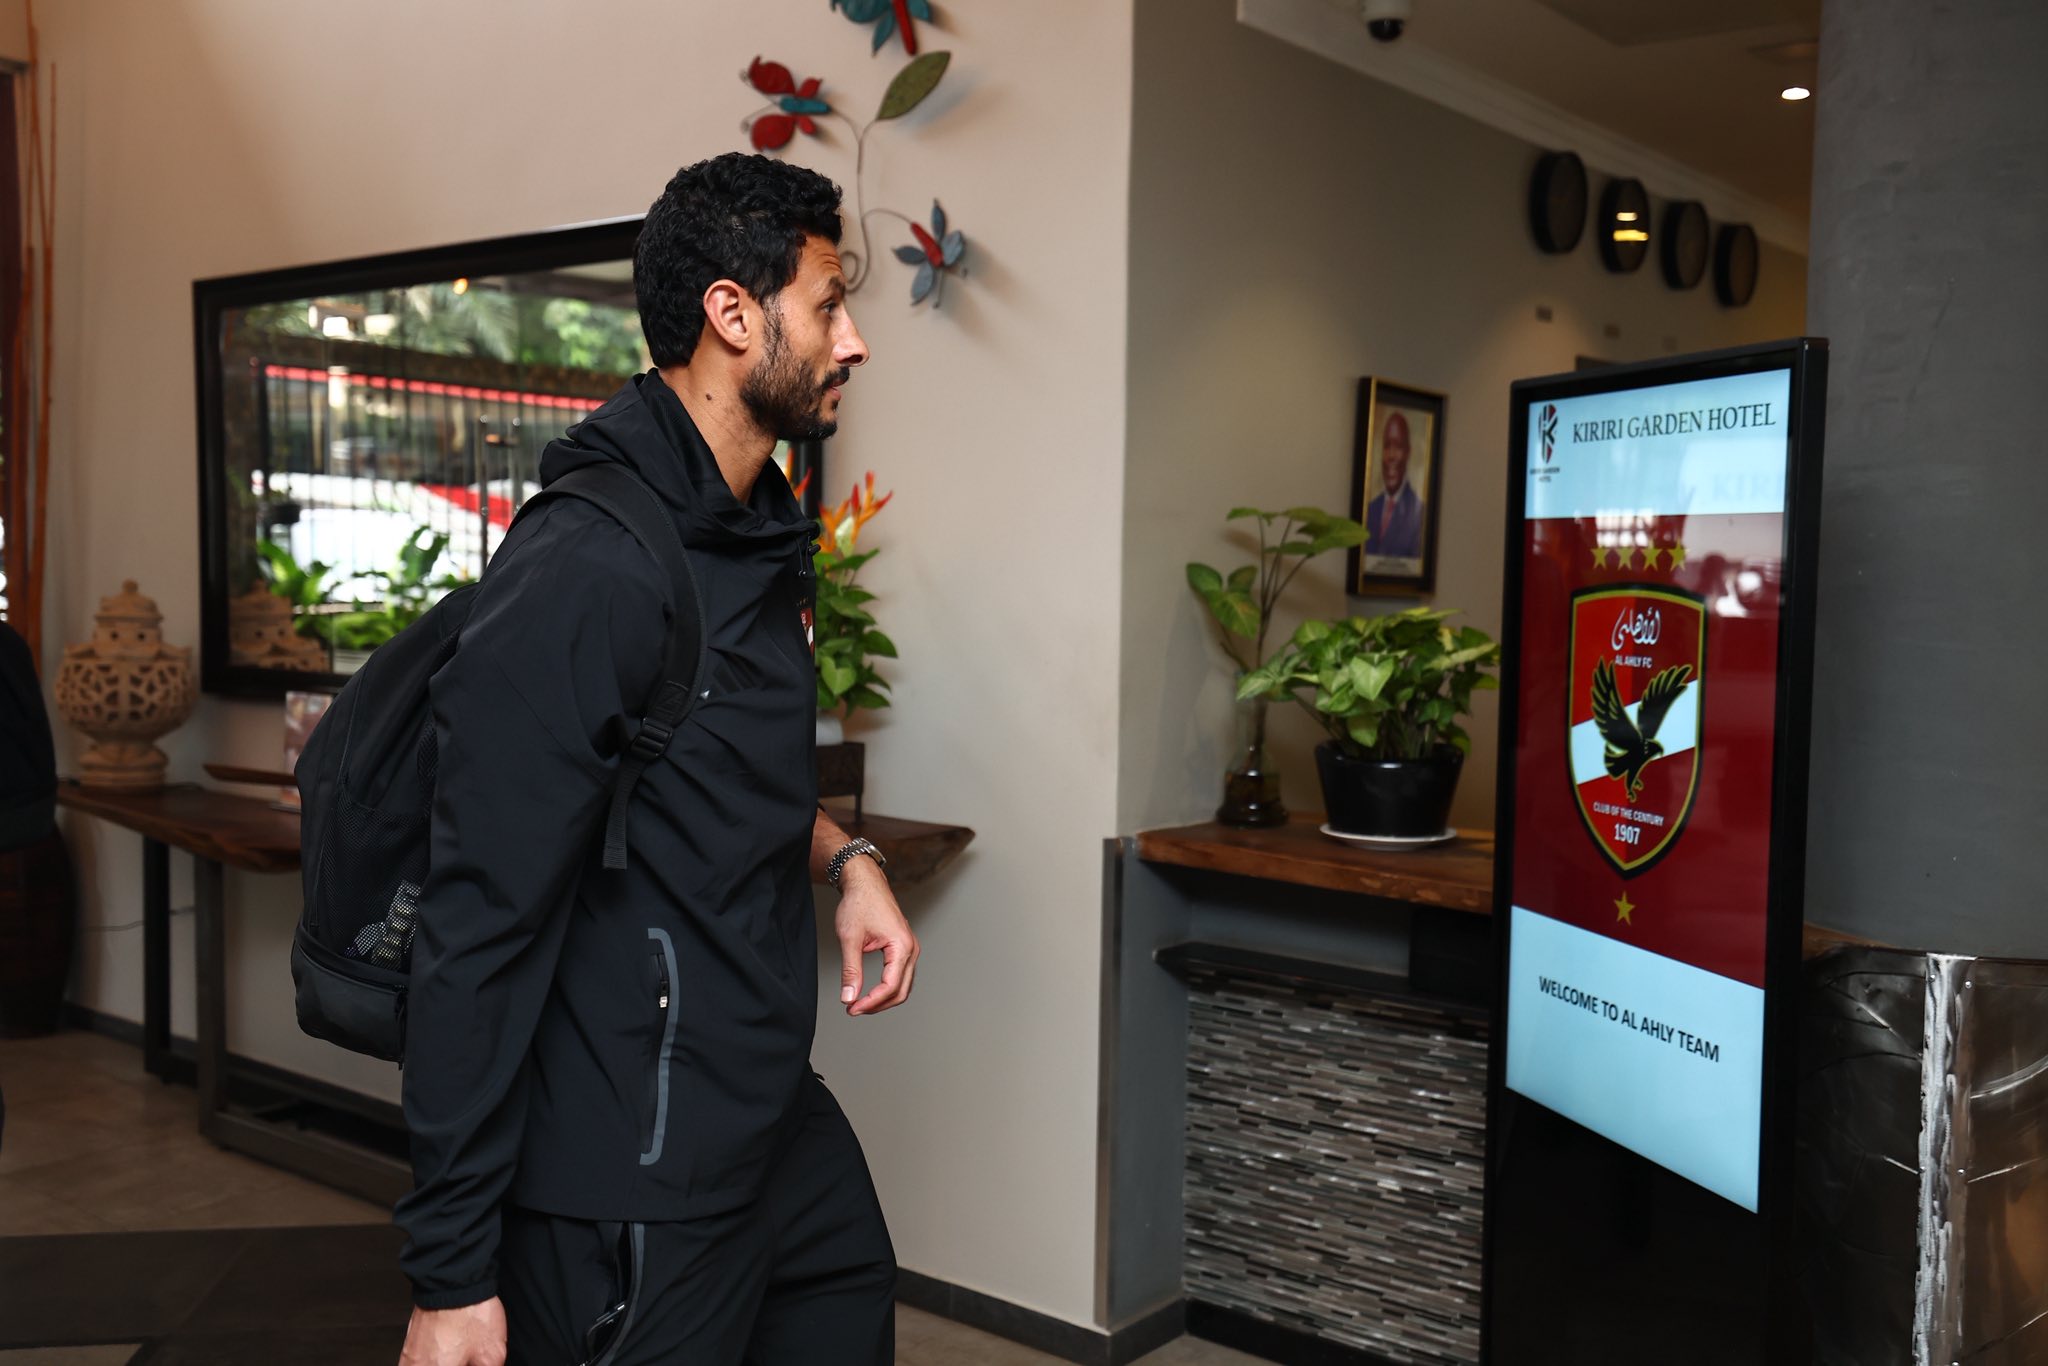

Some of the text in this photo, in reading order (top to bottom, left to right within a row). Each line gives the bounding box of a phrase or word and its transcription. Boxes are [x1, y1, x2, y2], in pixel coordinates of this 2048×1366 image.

[1573, 402, 1776, 443] KIRIRI GARDEN HOTEL
[1625, 655, 1642, 668] AHLY
[1642, 657, 1652, 669] FC
[1593, 802, 1664, 826] CLUB OF THE CENTURY
[1614, 822, 1641, 845] 1907
[1539, 975, 1720, 1063] WELCOME TO AL AHLY TEAM
